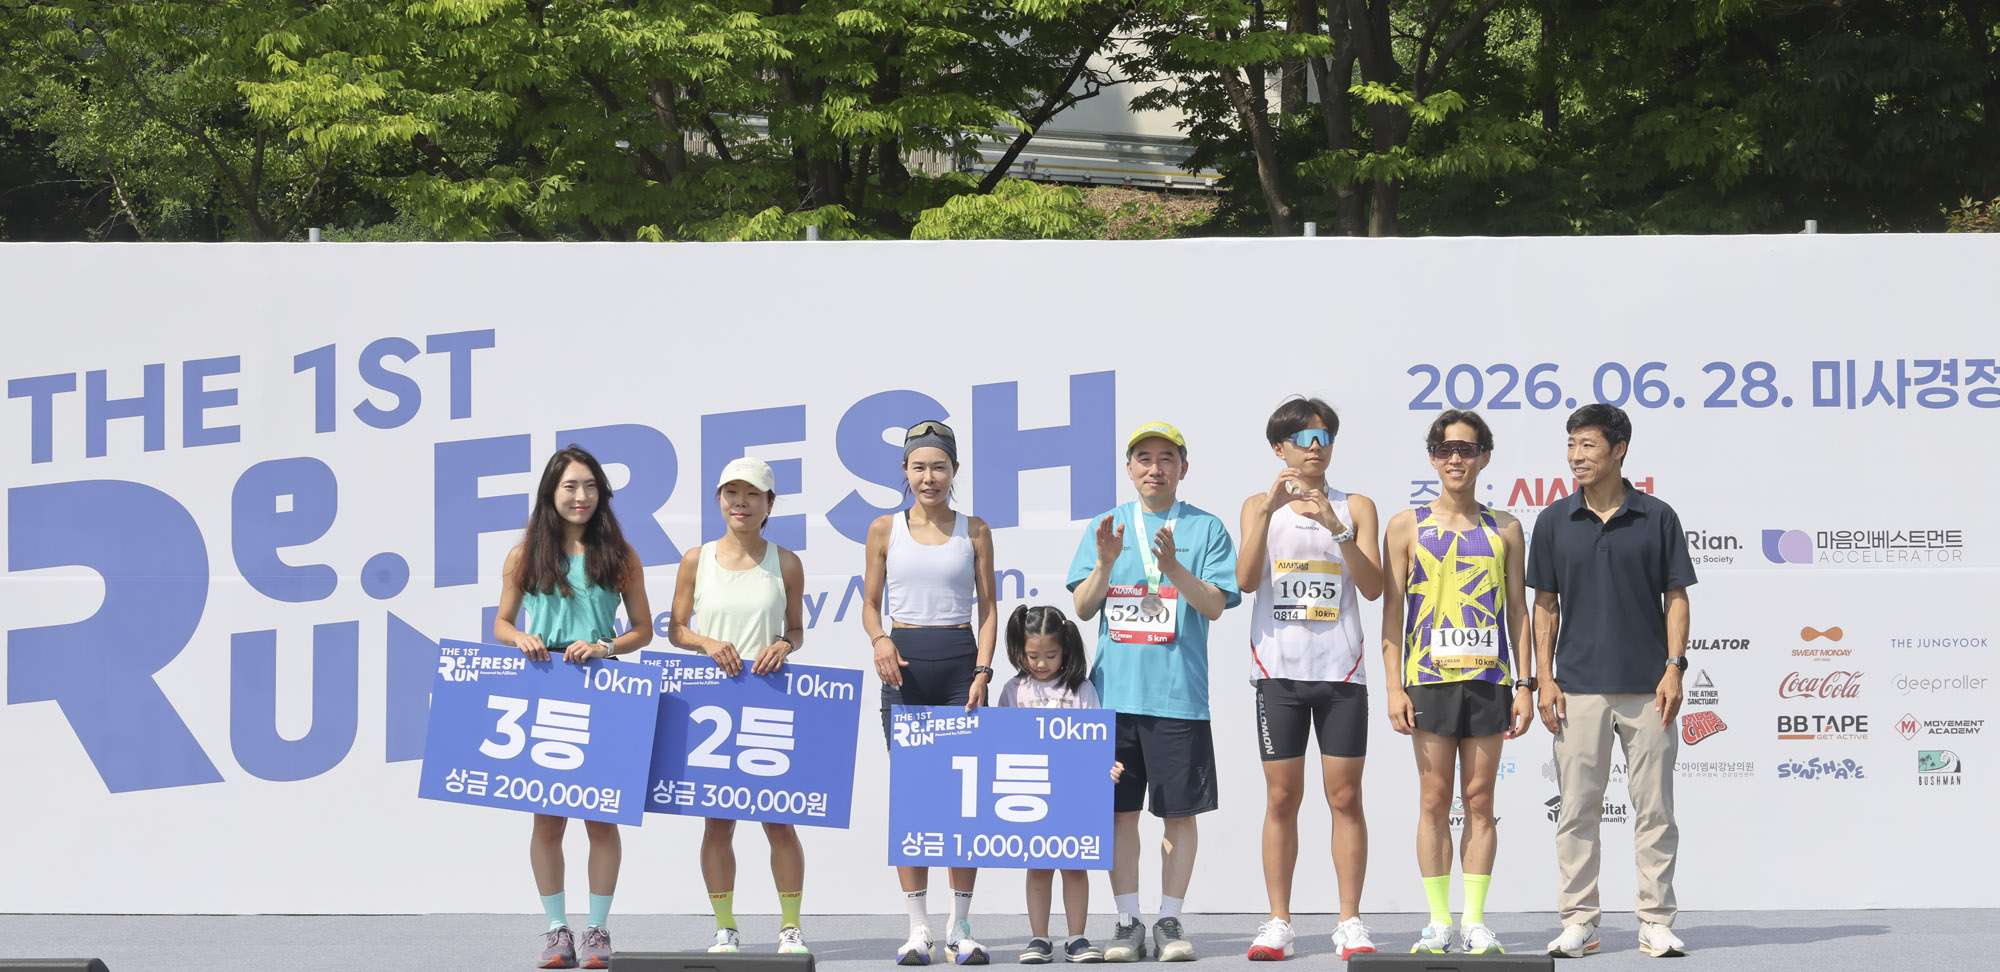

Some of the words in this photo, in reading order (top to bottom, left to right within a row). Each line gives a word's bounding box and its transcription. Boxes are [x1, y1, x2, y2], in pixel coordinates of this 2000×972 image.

[1407, 363, 1576, 411] 2026.
[1592, 361, 1686, 409] 06.
[1702, 360, 1793, 408] 28.
[8, 355, 240, 464] THE
[294, 329, 495, 434] 1ST
[1685, 530, 1743, 550] Rian.
[1817, 530, 1963, 550] 마음인베스트먼트
[1703, 555, 1734, 564] Society
[1819, 550, 1962, 563] ACCELERATOR
[1280, 580, 1336, 599] 1055
[1274, 611, 1298, 620] 0814
[1439, 629, 1493, 647] 1094
[1891, 638, 1912, 648] THE
[1917, 637, 1988, 648] JUNGYOOK
[441, 648, 460, 656] THE
[463, 648, 480, 656] 1ST
[665, 659, 681, 667] 1ST
[582, 666, 653, 697] 10km
[784, 672, 854, 700] 10km
[1897, 675, 1988, 693] deeproller
[894, 713, 913, 722] THE
[916, 711, 932, 720] 1ST
[1258, 693, 1275, 755] SALOMON
[1682, 711, 1716, 725] MEGA
[1778, 715, 1808, 732] BB
[1812, 715, 1868, 732] TAPE
[478, 695, 591, 770] 3등
[1035, 716, 1107, 740] 10km
[1682, 719, 1727, 746] CHIPS
[687, 705, 795, 776] 2등
[1778, 757, 1865, 779] SUNSHADE
[952, 753, 1051, 822] 1등
[1919, 776, 1961, 786] BUSHMAN
[445, 769, 489, 796] 상금
[493, 775, 621, 814] 200,000원
[653, 780, 696, 806] 상금
[701, 784, 828, 817] 300,000원
[901, 832, 944, 856] 상금
[953, 833, 1100, 862] 1,000,000원
